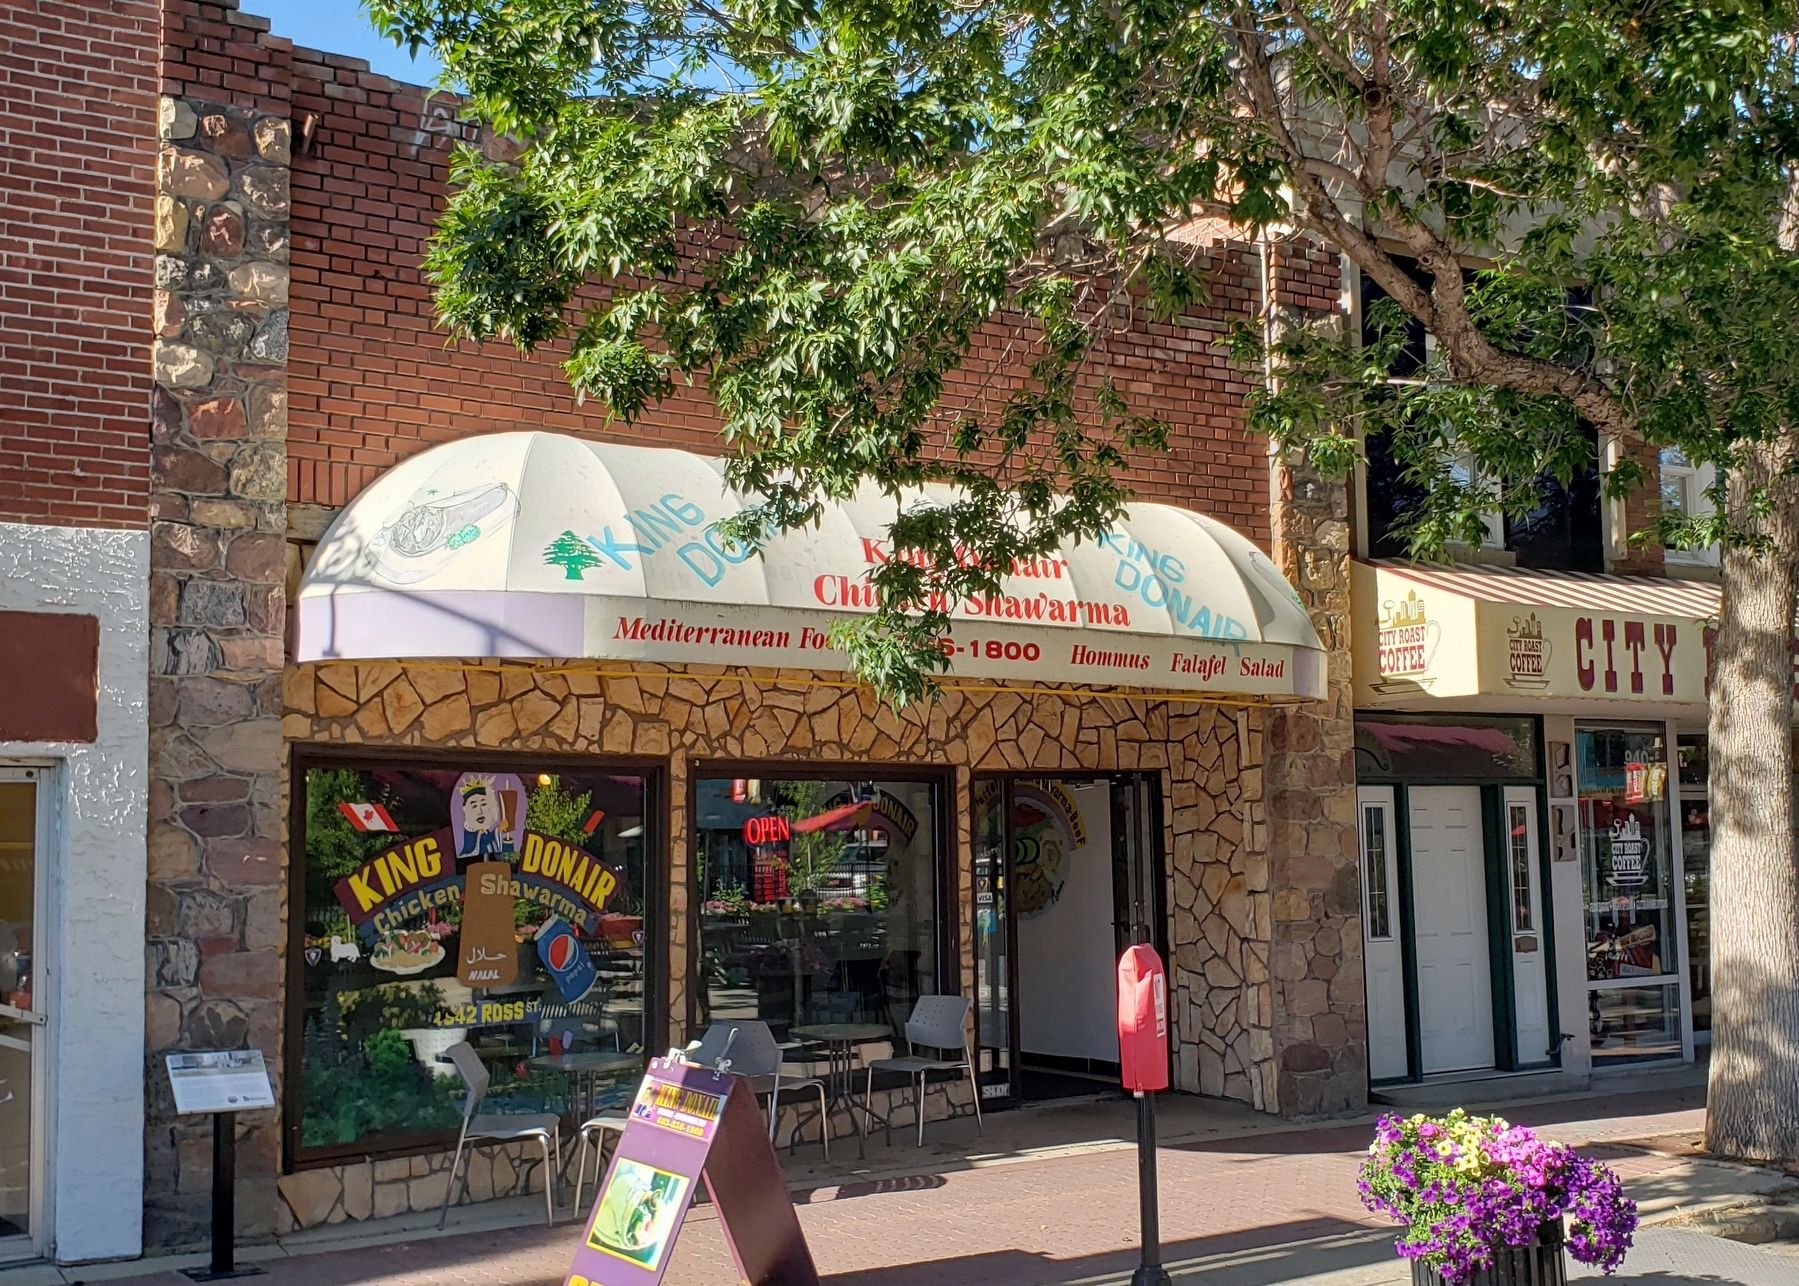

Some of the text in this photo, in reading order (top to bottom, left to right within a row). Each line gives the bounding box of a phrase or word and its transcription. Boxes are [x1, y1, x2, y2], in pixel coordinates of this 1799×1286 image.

[587, 494, 705, 571] KING
[1100, 531, 1185, 583] KING
[1115, 559, 1247, 657] DONAIR
[612, 616, 791, 649] Mediterranean
[798, 626, 848, 650] Fo
[1070, 644, 1150, 670] Hommus
[1170, 652, 1227, 681] Falafel
[1239, 656, 1285, 679] Salad
[1379, 625, 1426, 646] CITY ROAST
[1509, 638, 1542, 653] CITY ROAST
[1379, 644, 1426, 673] COFFEE
[1509, 653, 1543, 674] COFFEE
[1575, 617, 1677, 695] CITY
[746, 815, 790, 845] OPEN
[1611, 842, 1641, 855] CITY ROAST
[1611, 855, 1641, 871] COFFEE
[348, 833, 616, 913] KING DONAIR
[373, 873, 587, 935] Chicken Shawarma
[466, 946, 507, 964] حلال
[469, 968, 500, 981] HALAL
[482, 1000, 525, 1024] ROSS
